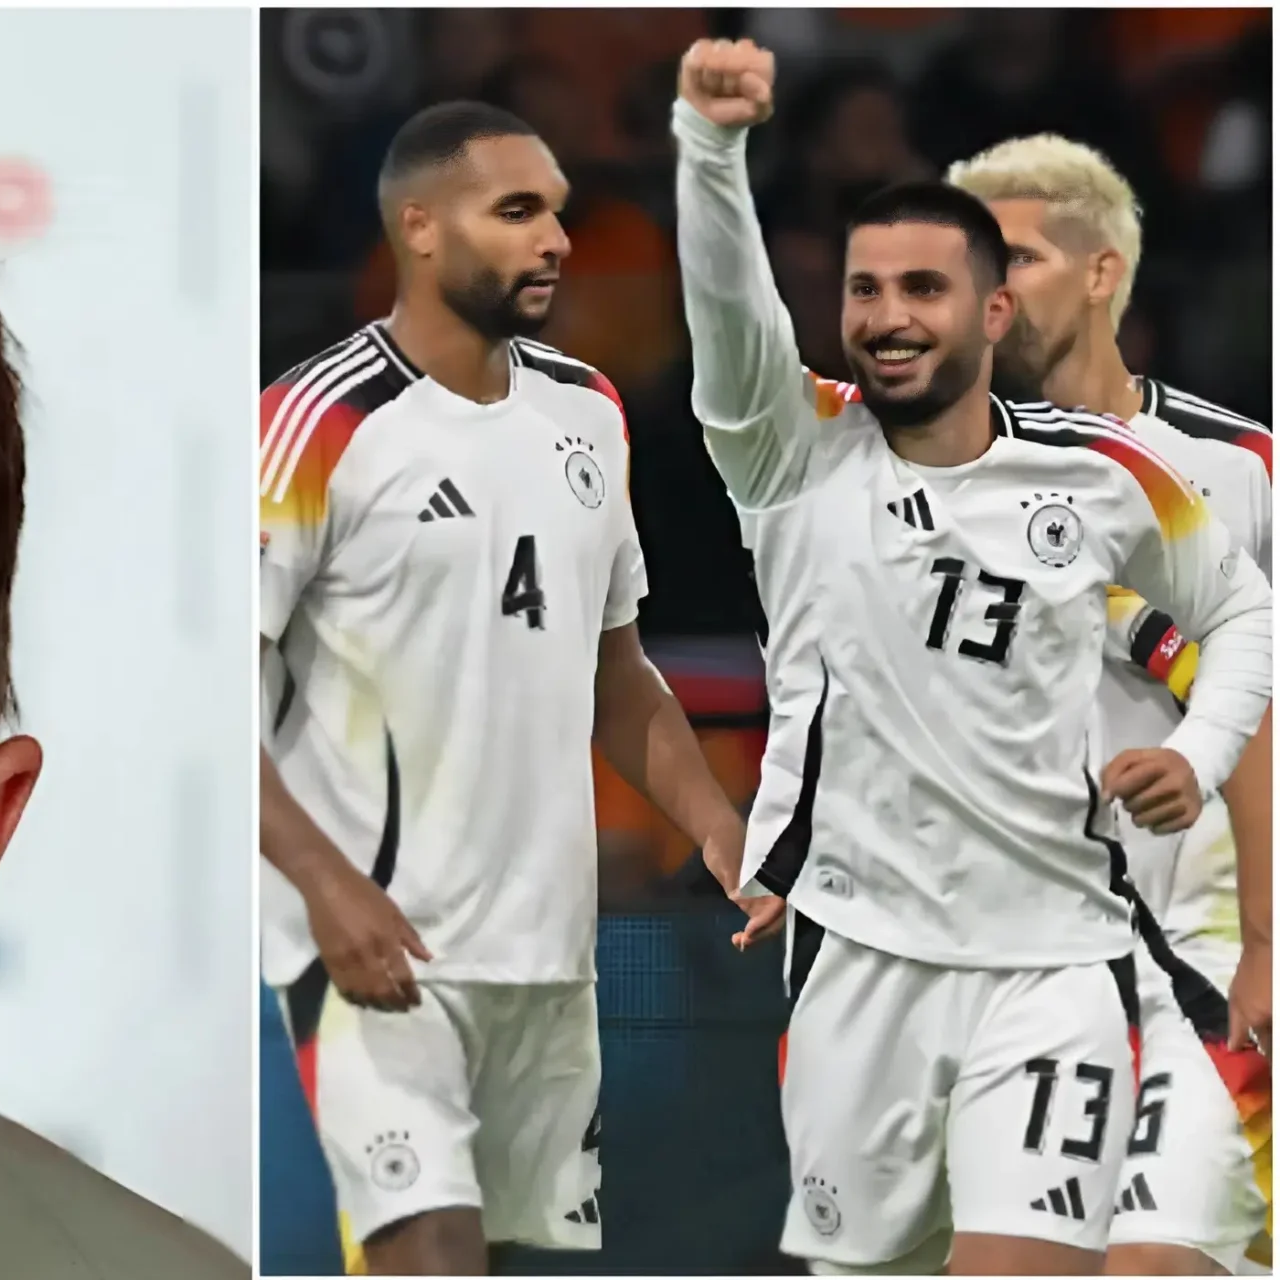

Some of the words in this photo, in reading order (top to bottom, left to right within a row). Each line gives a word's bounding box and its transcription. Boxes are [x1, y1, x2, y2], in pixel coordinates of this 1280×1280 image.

[501, 534, 546, 630] 4
[925, 556, 1026, 667] 13
[1022, 1057, 1114, 1163] 13
